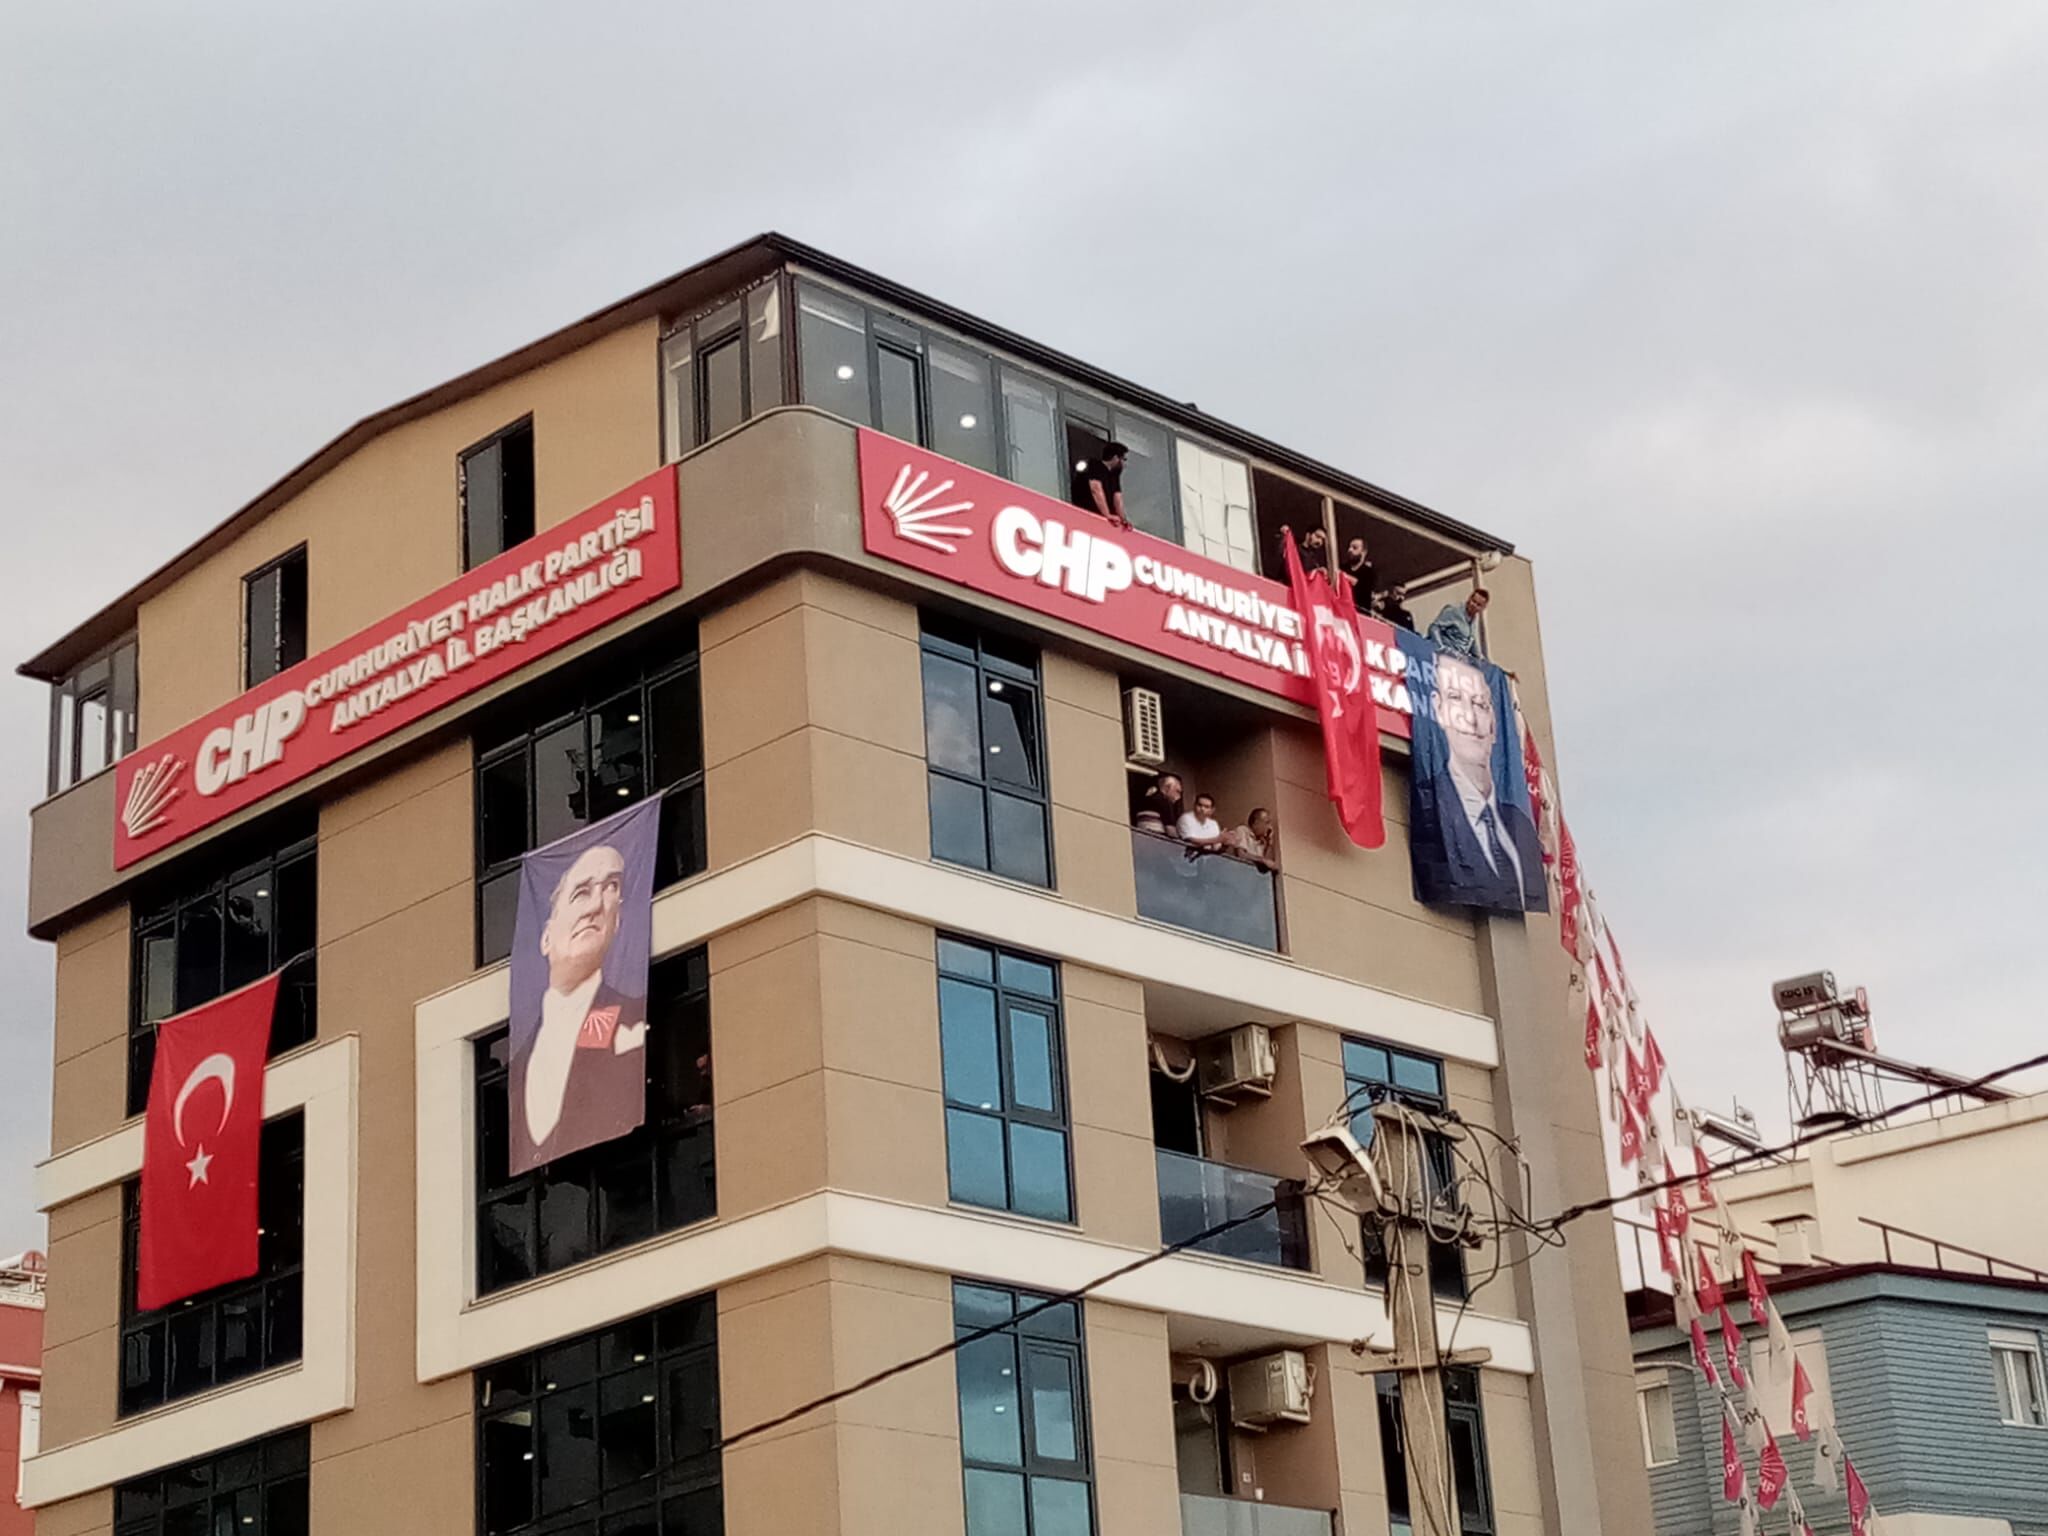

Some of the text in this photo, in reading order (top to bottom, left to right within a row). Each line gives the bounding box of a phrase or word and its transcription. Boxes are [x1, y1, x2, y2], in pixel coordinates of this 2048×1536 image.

[304, 495, 655, 707] CUMHURİYET HALK PARTİSİ
[991, 506, 1133, 603] CHP
[1134, 555, 1304, 640] CUMHURİYET
[331, 547, 642, 733] ANTALYA İL BAŞKANLIĞI
[1164, 604, 1293, 671] ANTALYA
[195, 690, 306, 796] CHP
